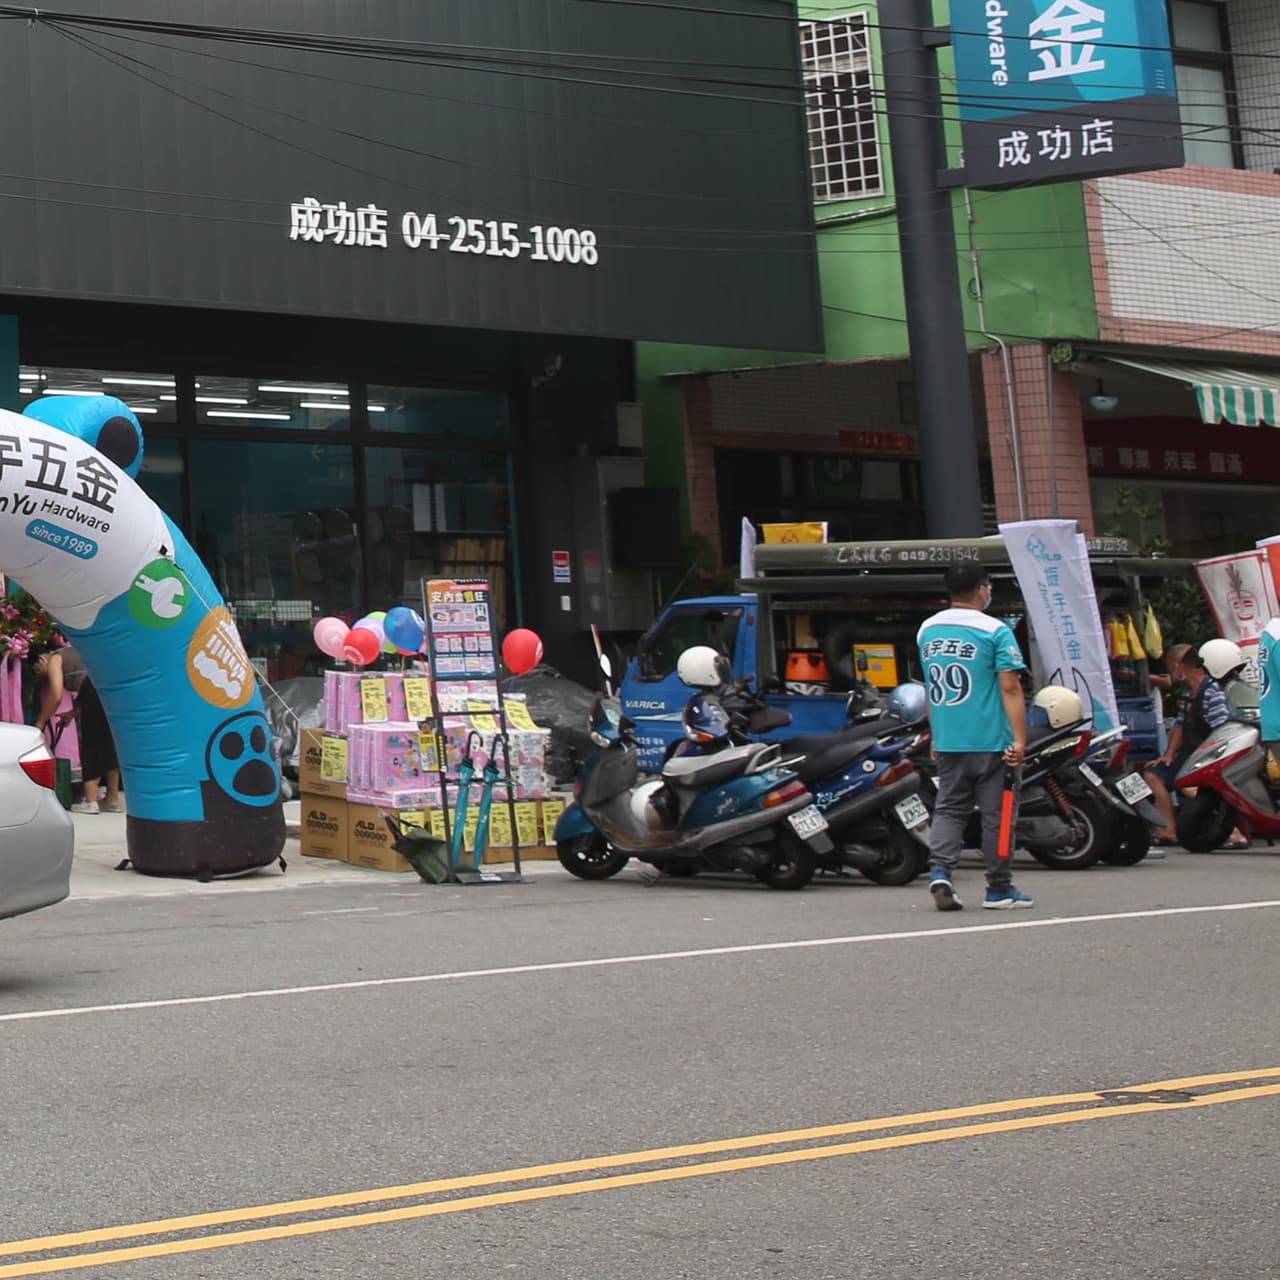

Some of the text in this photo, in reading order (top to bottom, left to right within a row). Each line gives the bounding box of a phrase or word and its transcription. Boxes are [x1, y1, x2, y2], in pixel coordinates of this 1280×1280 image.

[997, 119, 1114, 169] 成功店
[290, 198, 598, 266] 成功店 04-2515-1008
[40, 498, 111, 533] Hardware
[31, 521, 94, 555] since1989
[928, 663, 972, 707] 89
[625, 700, 666, 710] VARICA
